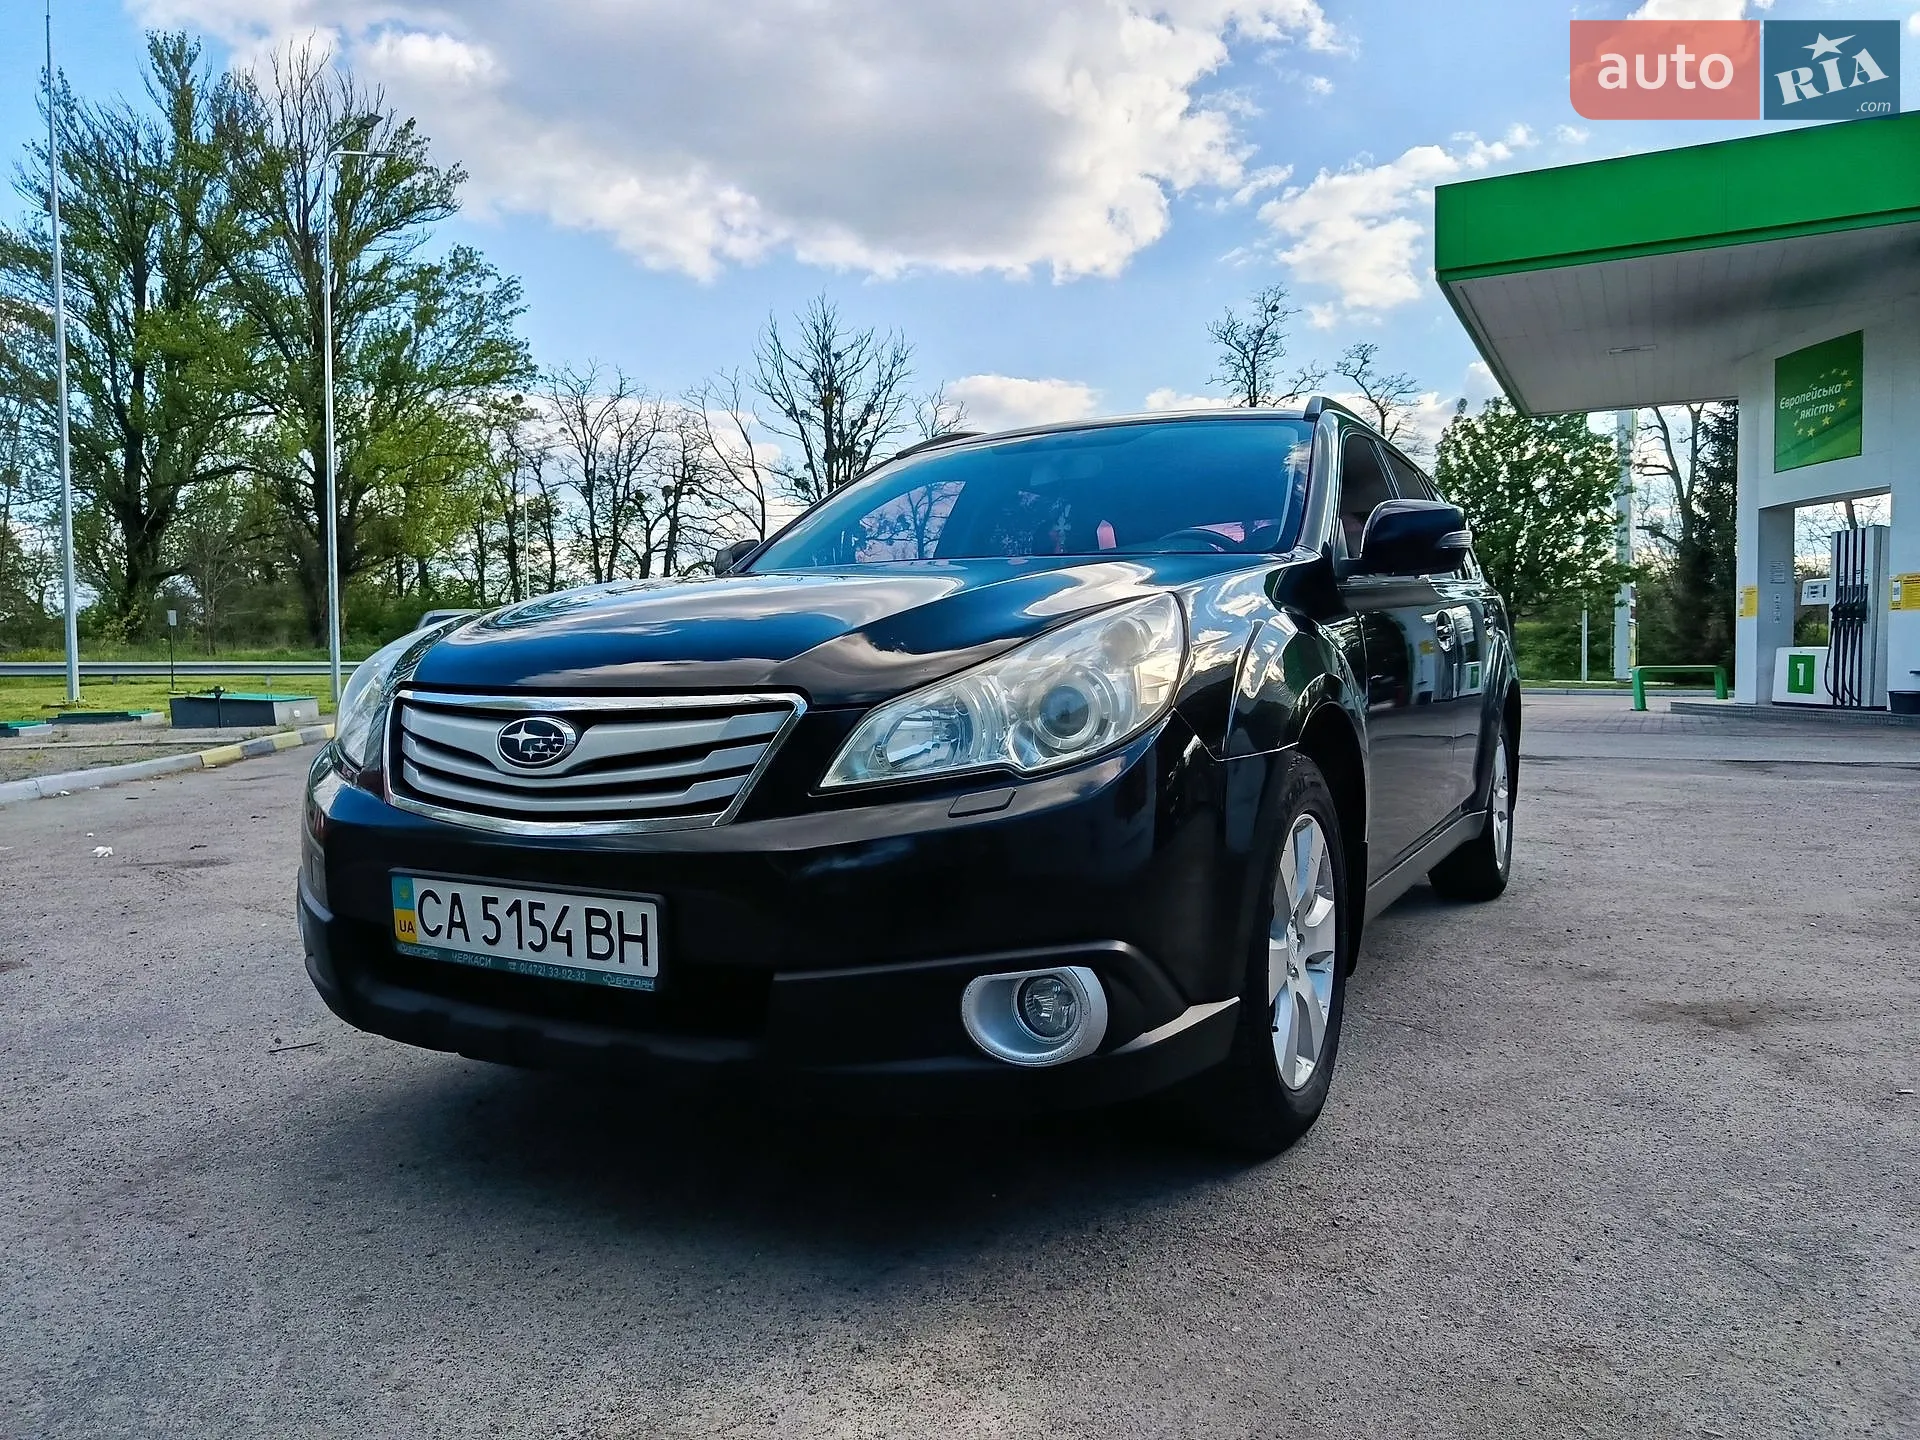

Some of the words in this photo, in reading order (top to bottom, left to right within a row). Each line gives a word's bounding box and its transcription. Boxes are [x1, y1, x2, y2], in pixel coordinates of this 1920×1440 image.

[1779, 382, 1842, 410] Європейська
[1799, 402, 1836, 420] якість
[1796, 663, 1805, 686] 1
[399, 919, 415, 933] UA
[417, 889, 470, 943] CA
[481, 895, 574, 958] 5154
[584, 906, 648, 967] BH
